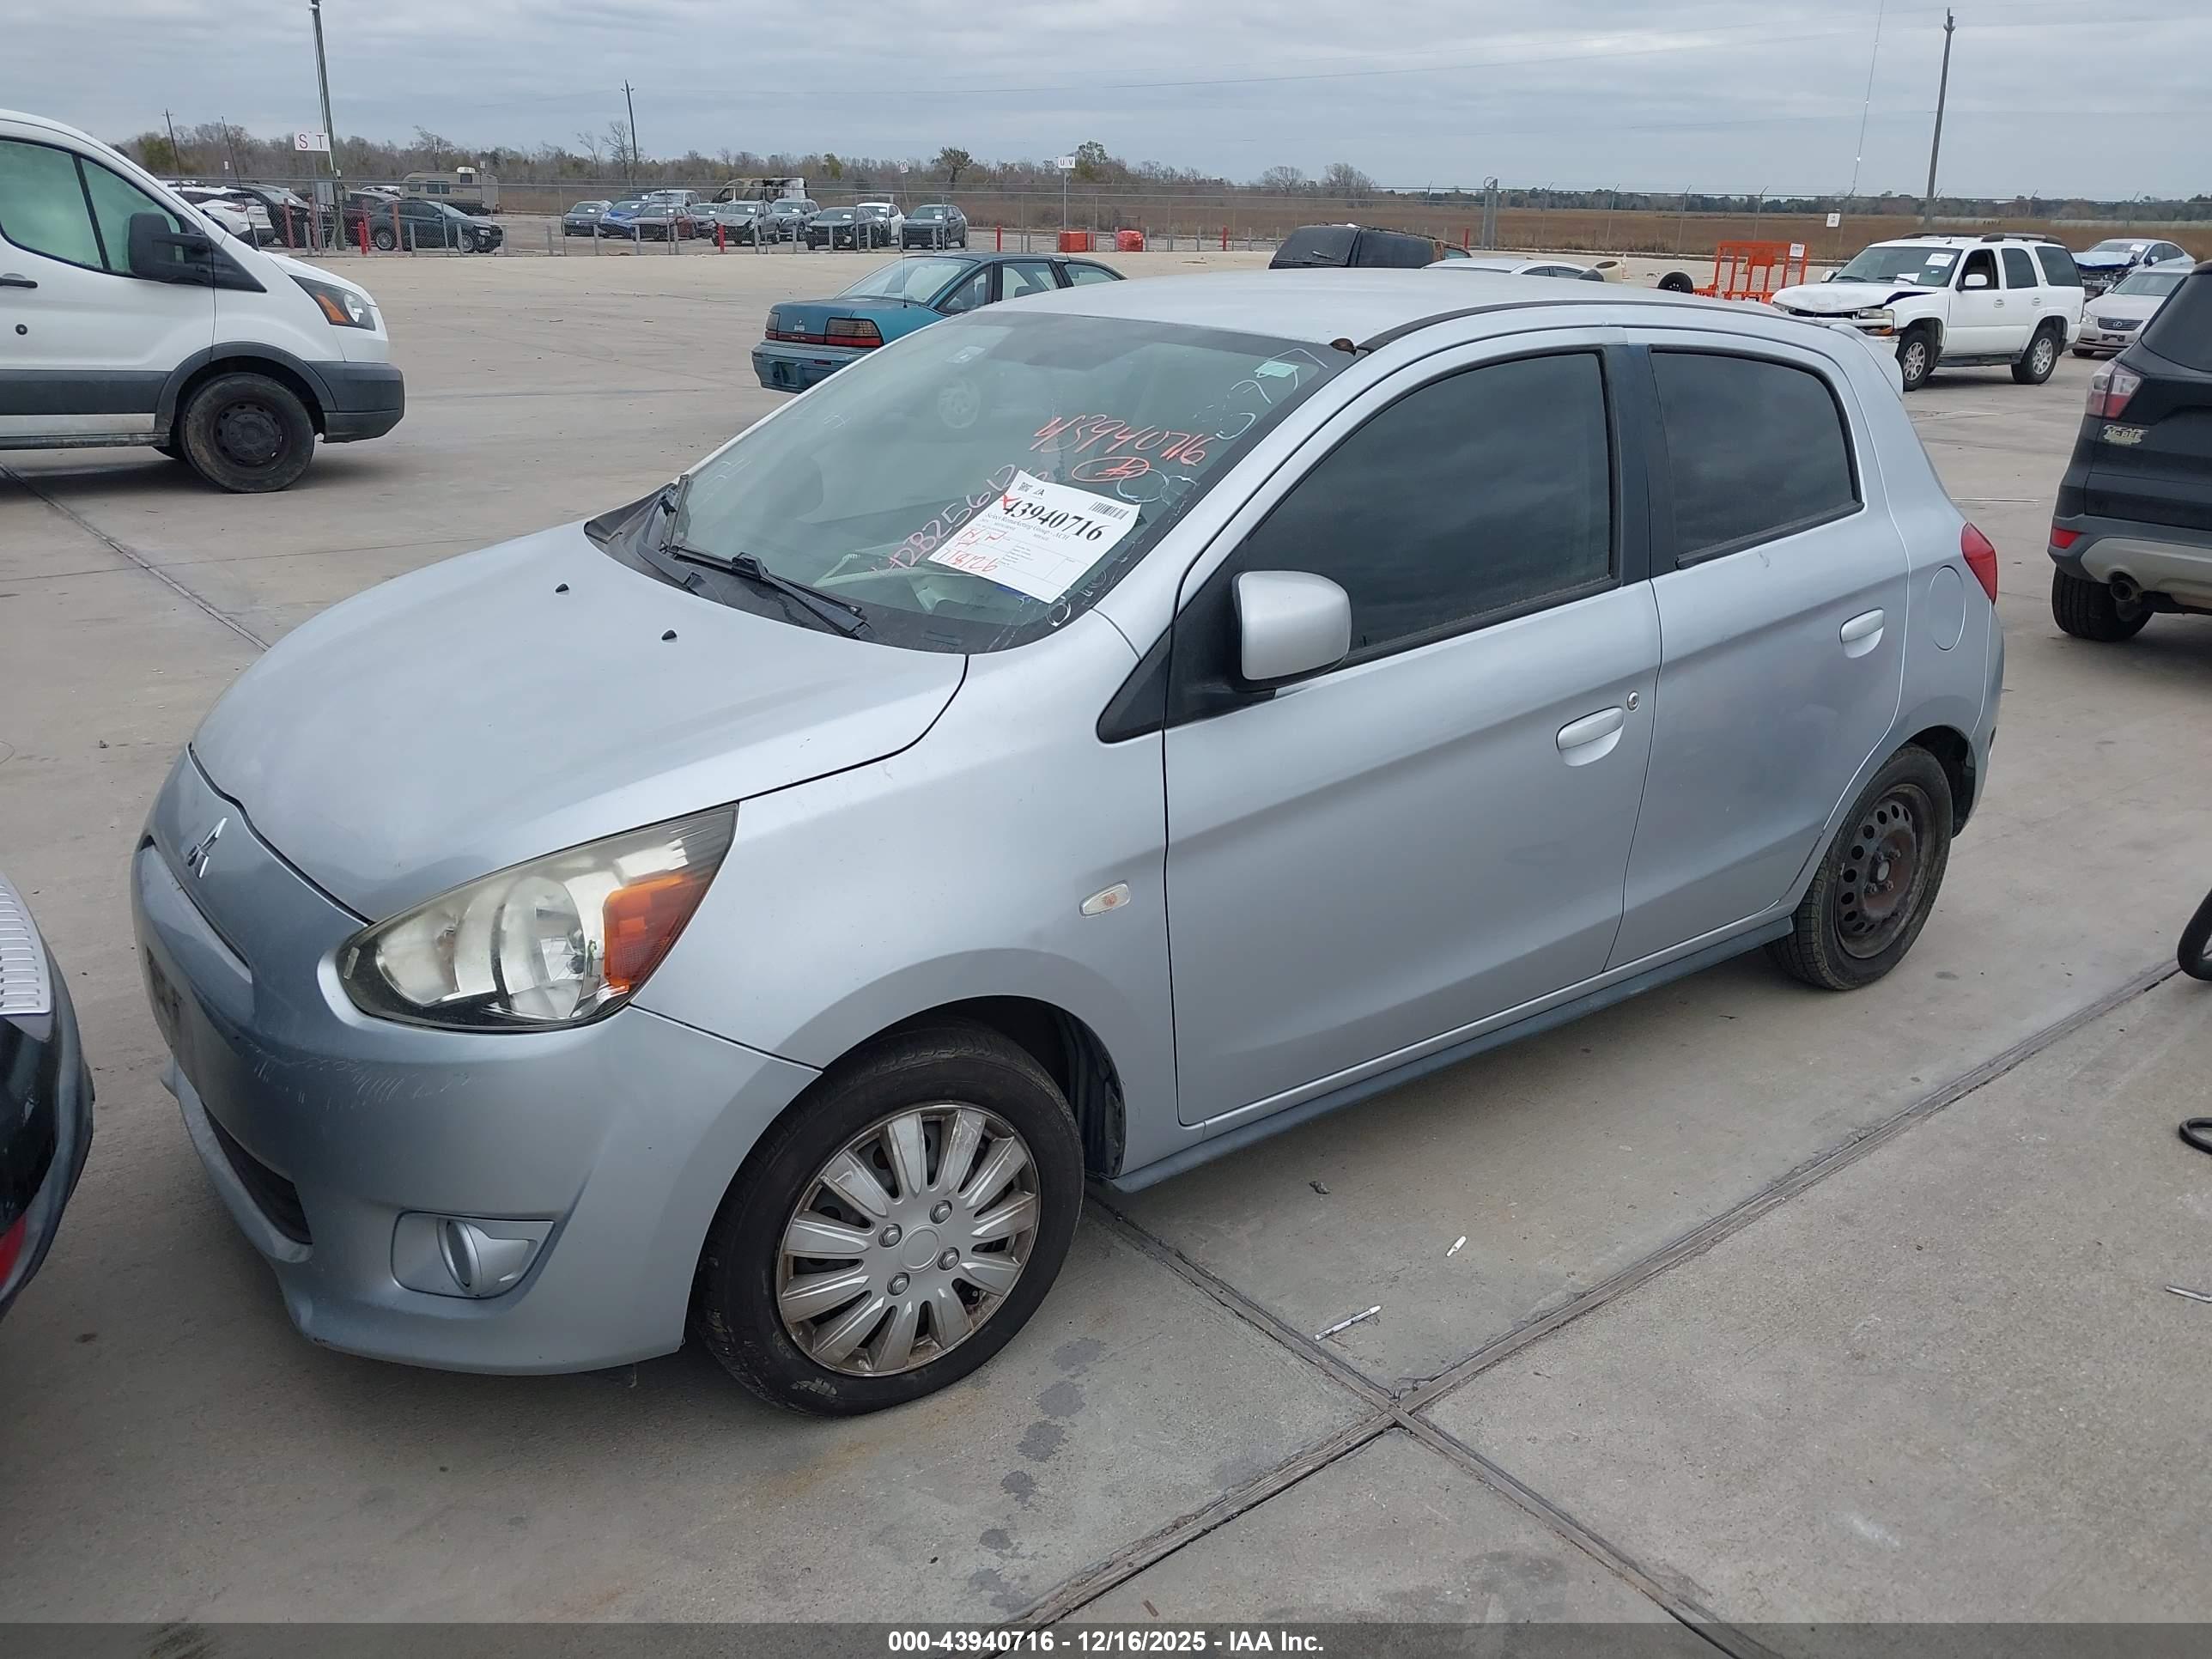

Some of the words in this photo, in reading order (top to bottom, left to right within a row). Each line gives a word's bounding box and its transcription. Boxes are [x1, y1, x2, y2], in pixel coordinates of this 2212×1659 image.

[298, 133, 308, 149] S
[315, 134, 325, 149] T
[1029, 414, 1216, 467] 43940716
[1002, 500, 1111, 541] 43940716
